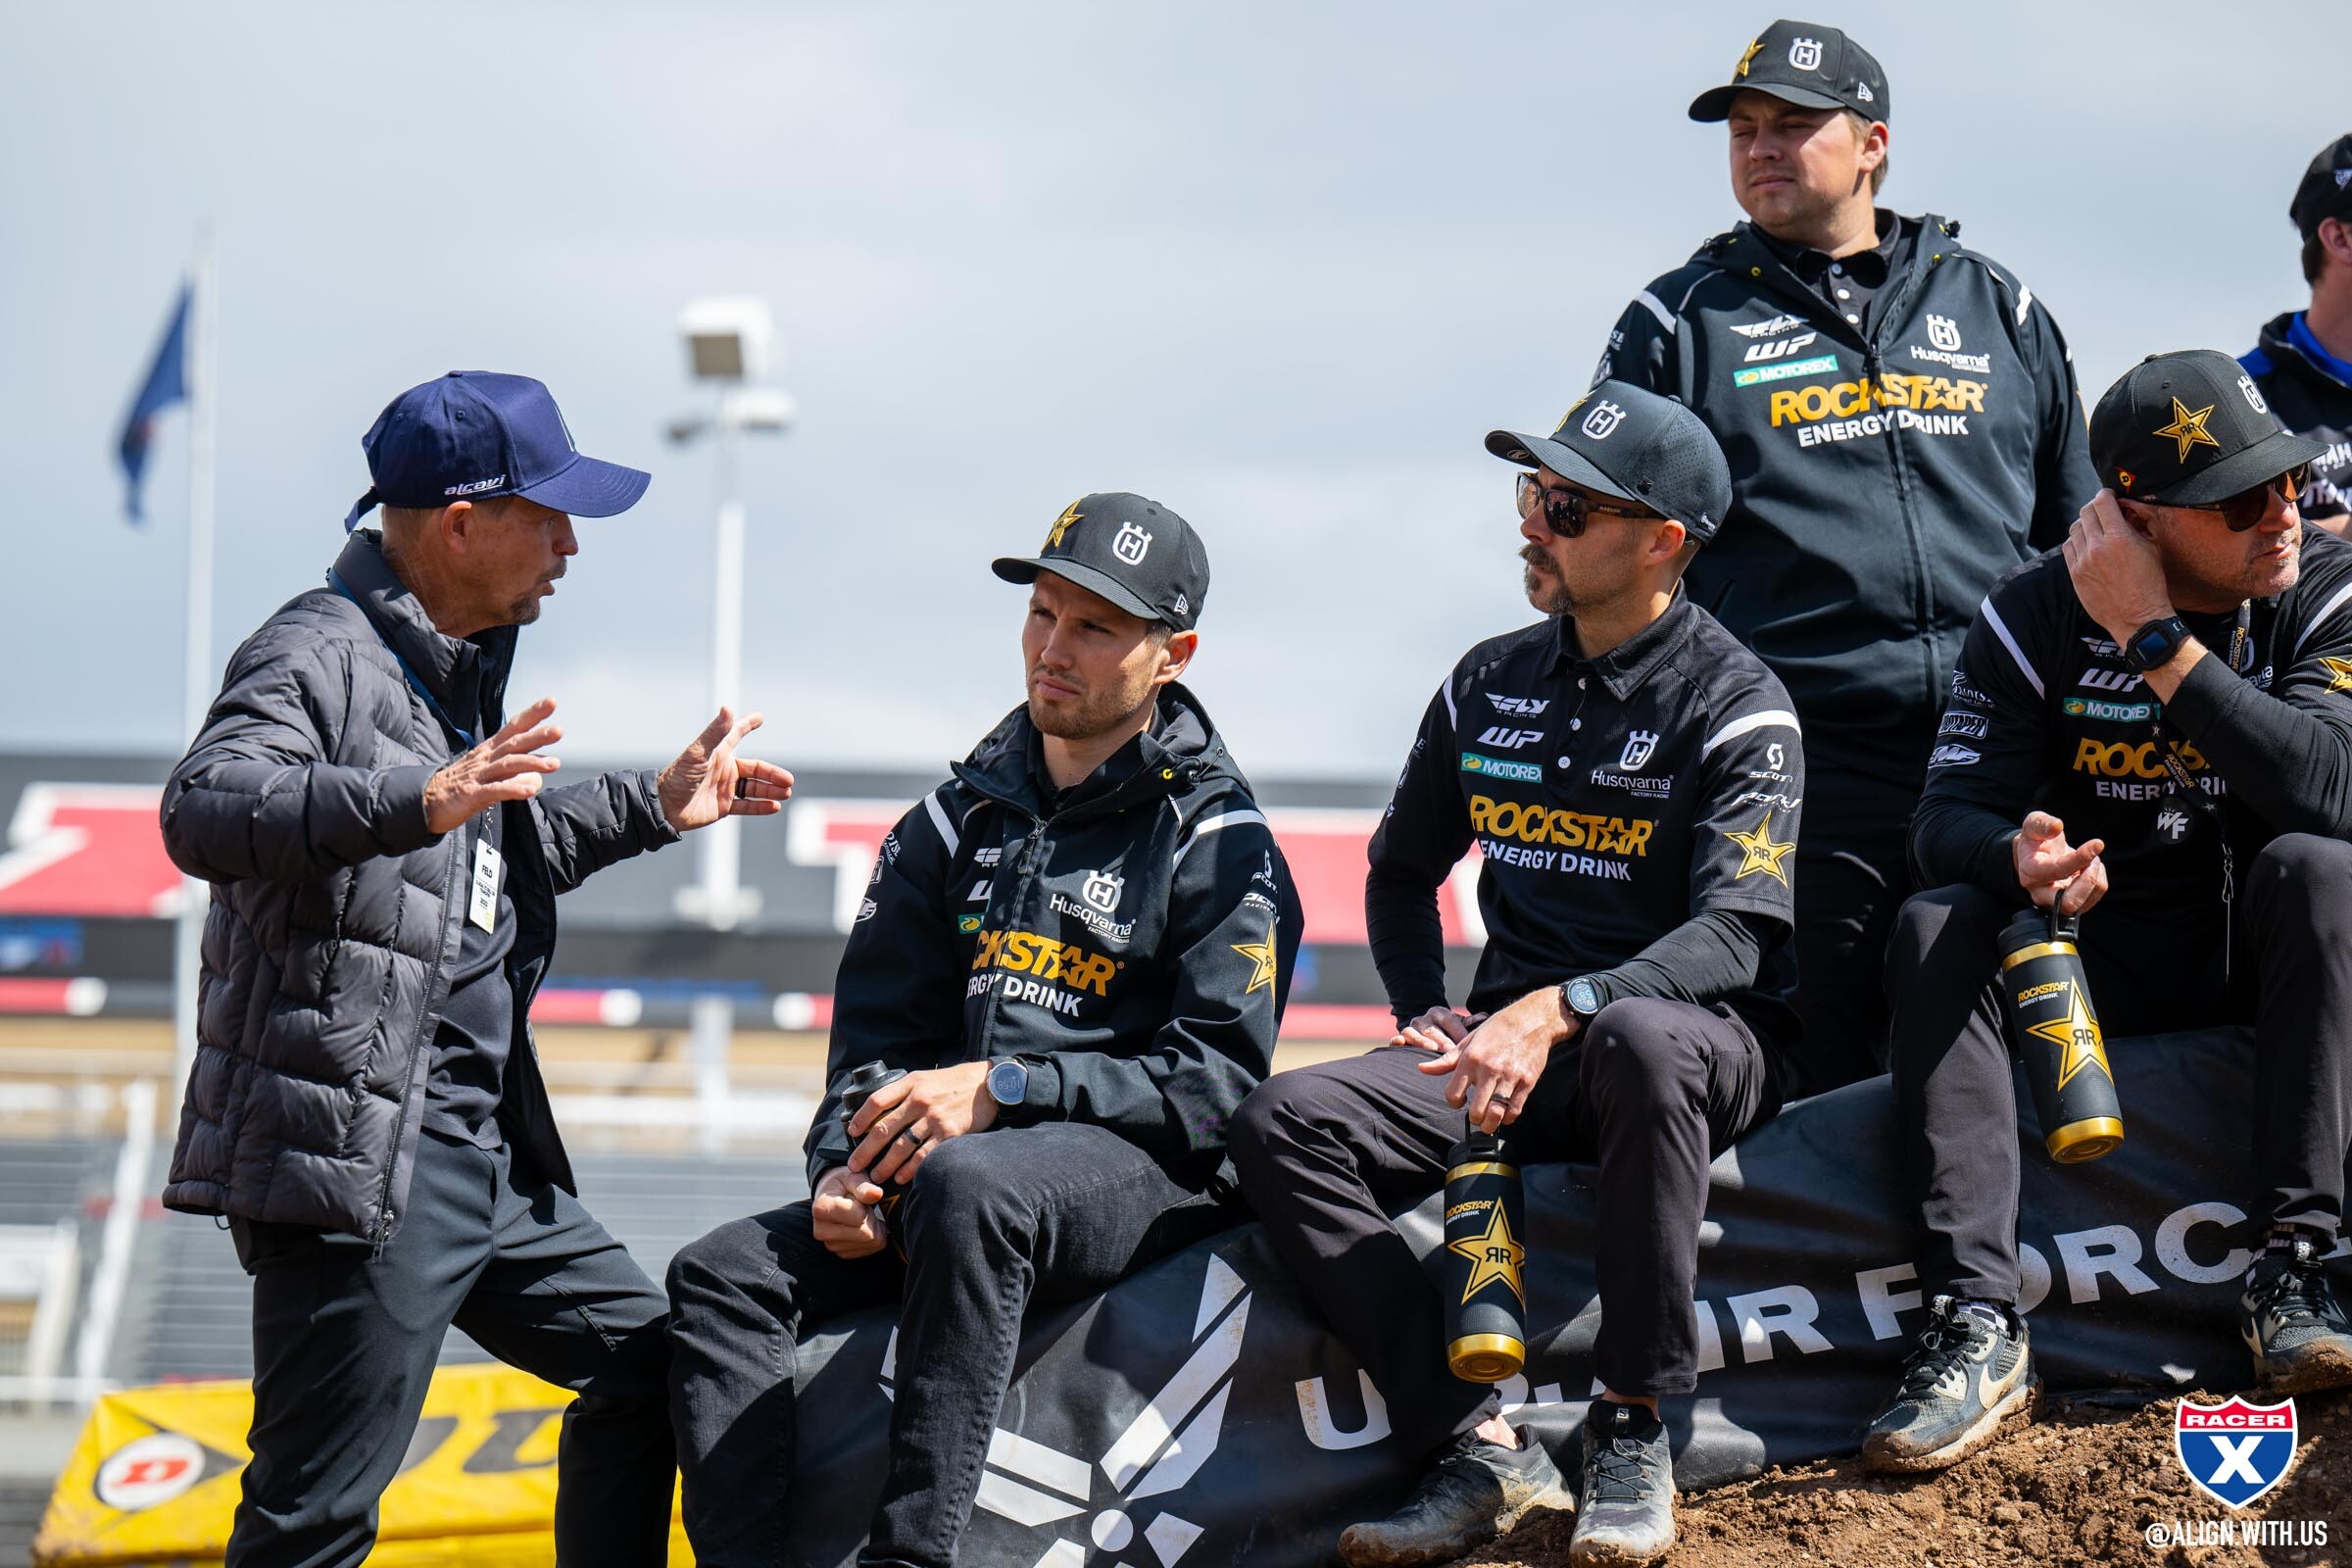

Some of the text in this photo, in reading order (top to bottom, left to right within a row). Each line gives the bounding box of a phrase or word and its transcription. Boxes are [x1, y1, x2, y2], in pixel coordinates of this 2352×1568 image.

[1744, 332, 1816, 363] WP
[1910, 345, 1986, 368] Husqvarna
[1759, 357, 1833, 381] MOTOREX
[1771, 373, 1984, 427] ROCKSTAR
[1797, 410, 1969, 447] ENERGY DRINK
[444, 473, 507, 496] alcavi
[2232, 626, 2245, 670] ROCKSTAR
[1486, 693, 1550, 713] FLY
[2086, 701, 2150, 720] MOTORE
[1477, 726, 1544, 750] WP
[1591, 769, 1671, 791] Husqvarna
[1471, 794, 1653, 857] ROCKSTAR
[481, 864, 494, 879] FELD
[1481, 841, 1632, 882] ENERGY DRINK
[1049, 893, 1132, 937] Husqvarna
[1088, 925, 1113, 942] FACTORY
[1004, 975, 1084, 1018] DRINK
[2018, 981, 2068, 1003] ROCKSTAR
[2019, 992, 2059, 1009] ENERGY DRINK
[1446, 1200, 1492, 1218] ROCKSTAR
